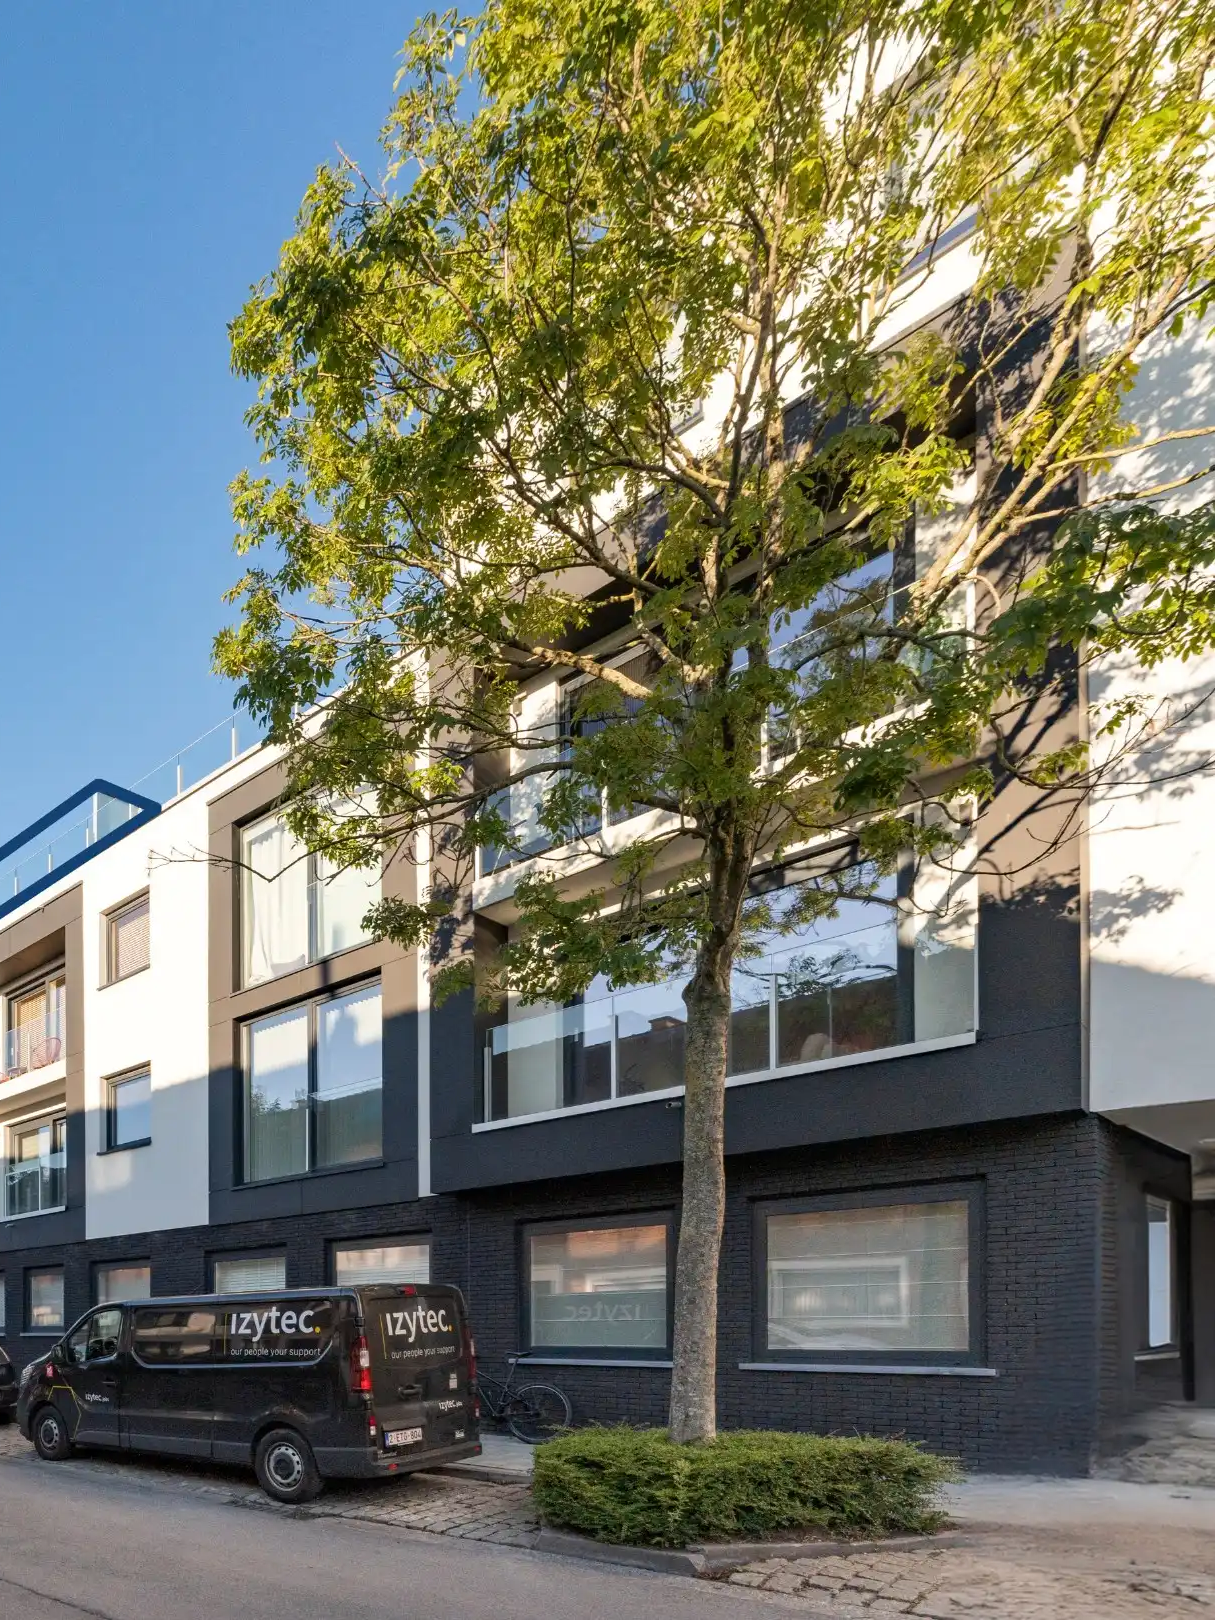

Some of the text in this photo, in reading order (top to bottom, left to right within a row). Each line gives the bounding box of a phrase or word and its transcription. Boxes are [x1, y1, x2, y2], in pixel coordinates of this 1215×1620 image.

[230, 1346, 322, 1357] our people your support
[390, 1345, 456, 1360] our people your support
